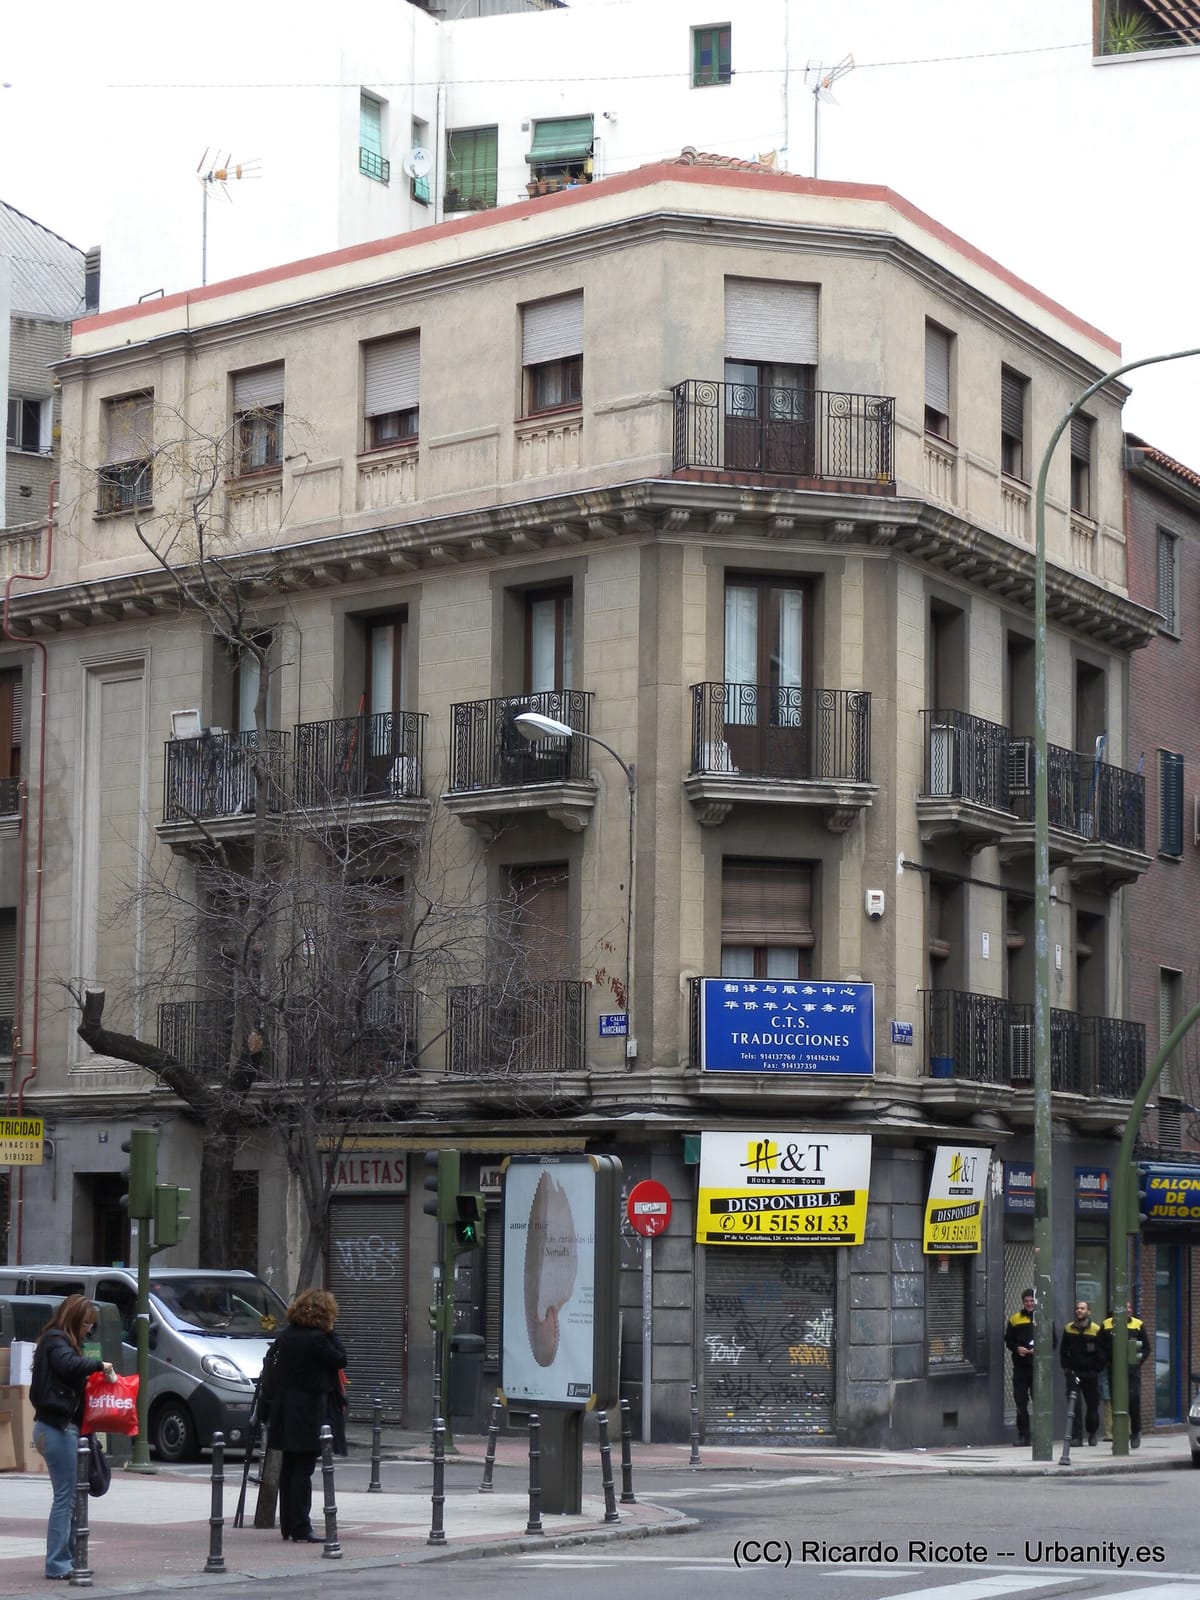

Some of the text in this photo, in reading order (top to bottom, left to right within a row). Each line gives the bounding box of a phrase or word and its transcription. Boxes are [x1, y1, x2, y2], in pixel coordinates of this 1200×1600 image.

[722, 983, 857, 996] 翻译与服务中心
[723, 1000, 857, 1014] 华侨华人事务所
[771, 1016, 810, 1028] C.T.S.
[731, 1032, 850, 1046] TRADUCCIONES
[0, 1121, 40, 1136] TRICIDAD
[728, 1192, 840, 1212] DISPONIBLE
[1166, 1192, 1186, 1204] DE
[938, 1204, 976, 1222] DISPONIBLE
[742, 1214, 848, 1232] 91 515 81 33
[942, 1226, 950, 1240] 91
[952, 1226, 963, 1240] 515
[544, 1247, 570, 1256] Neruda
